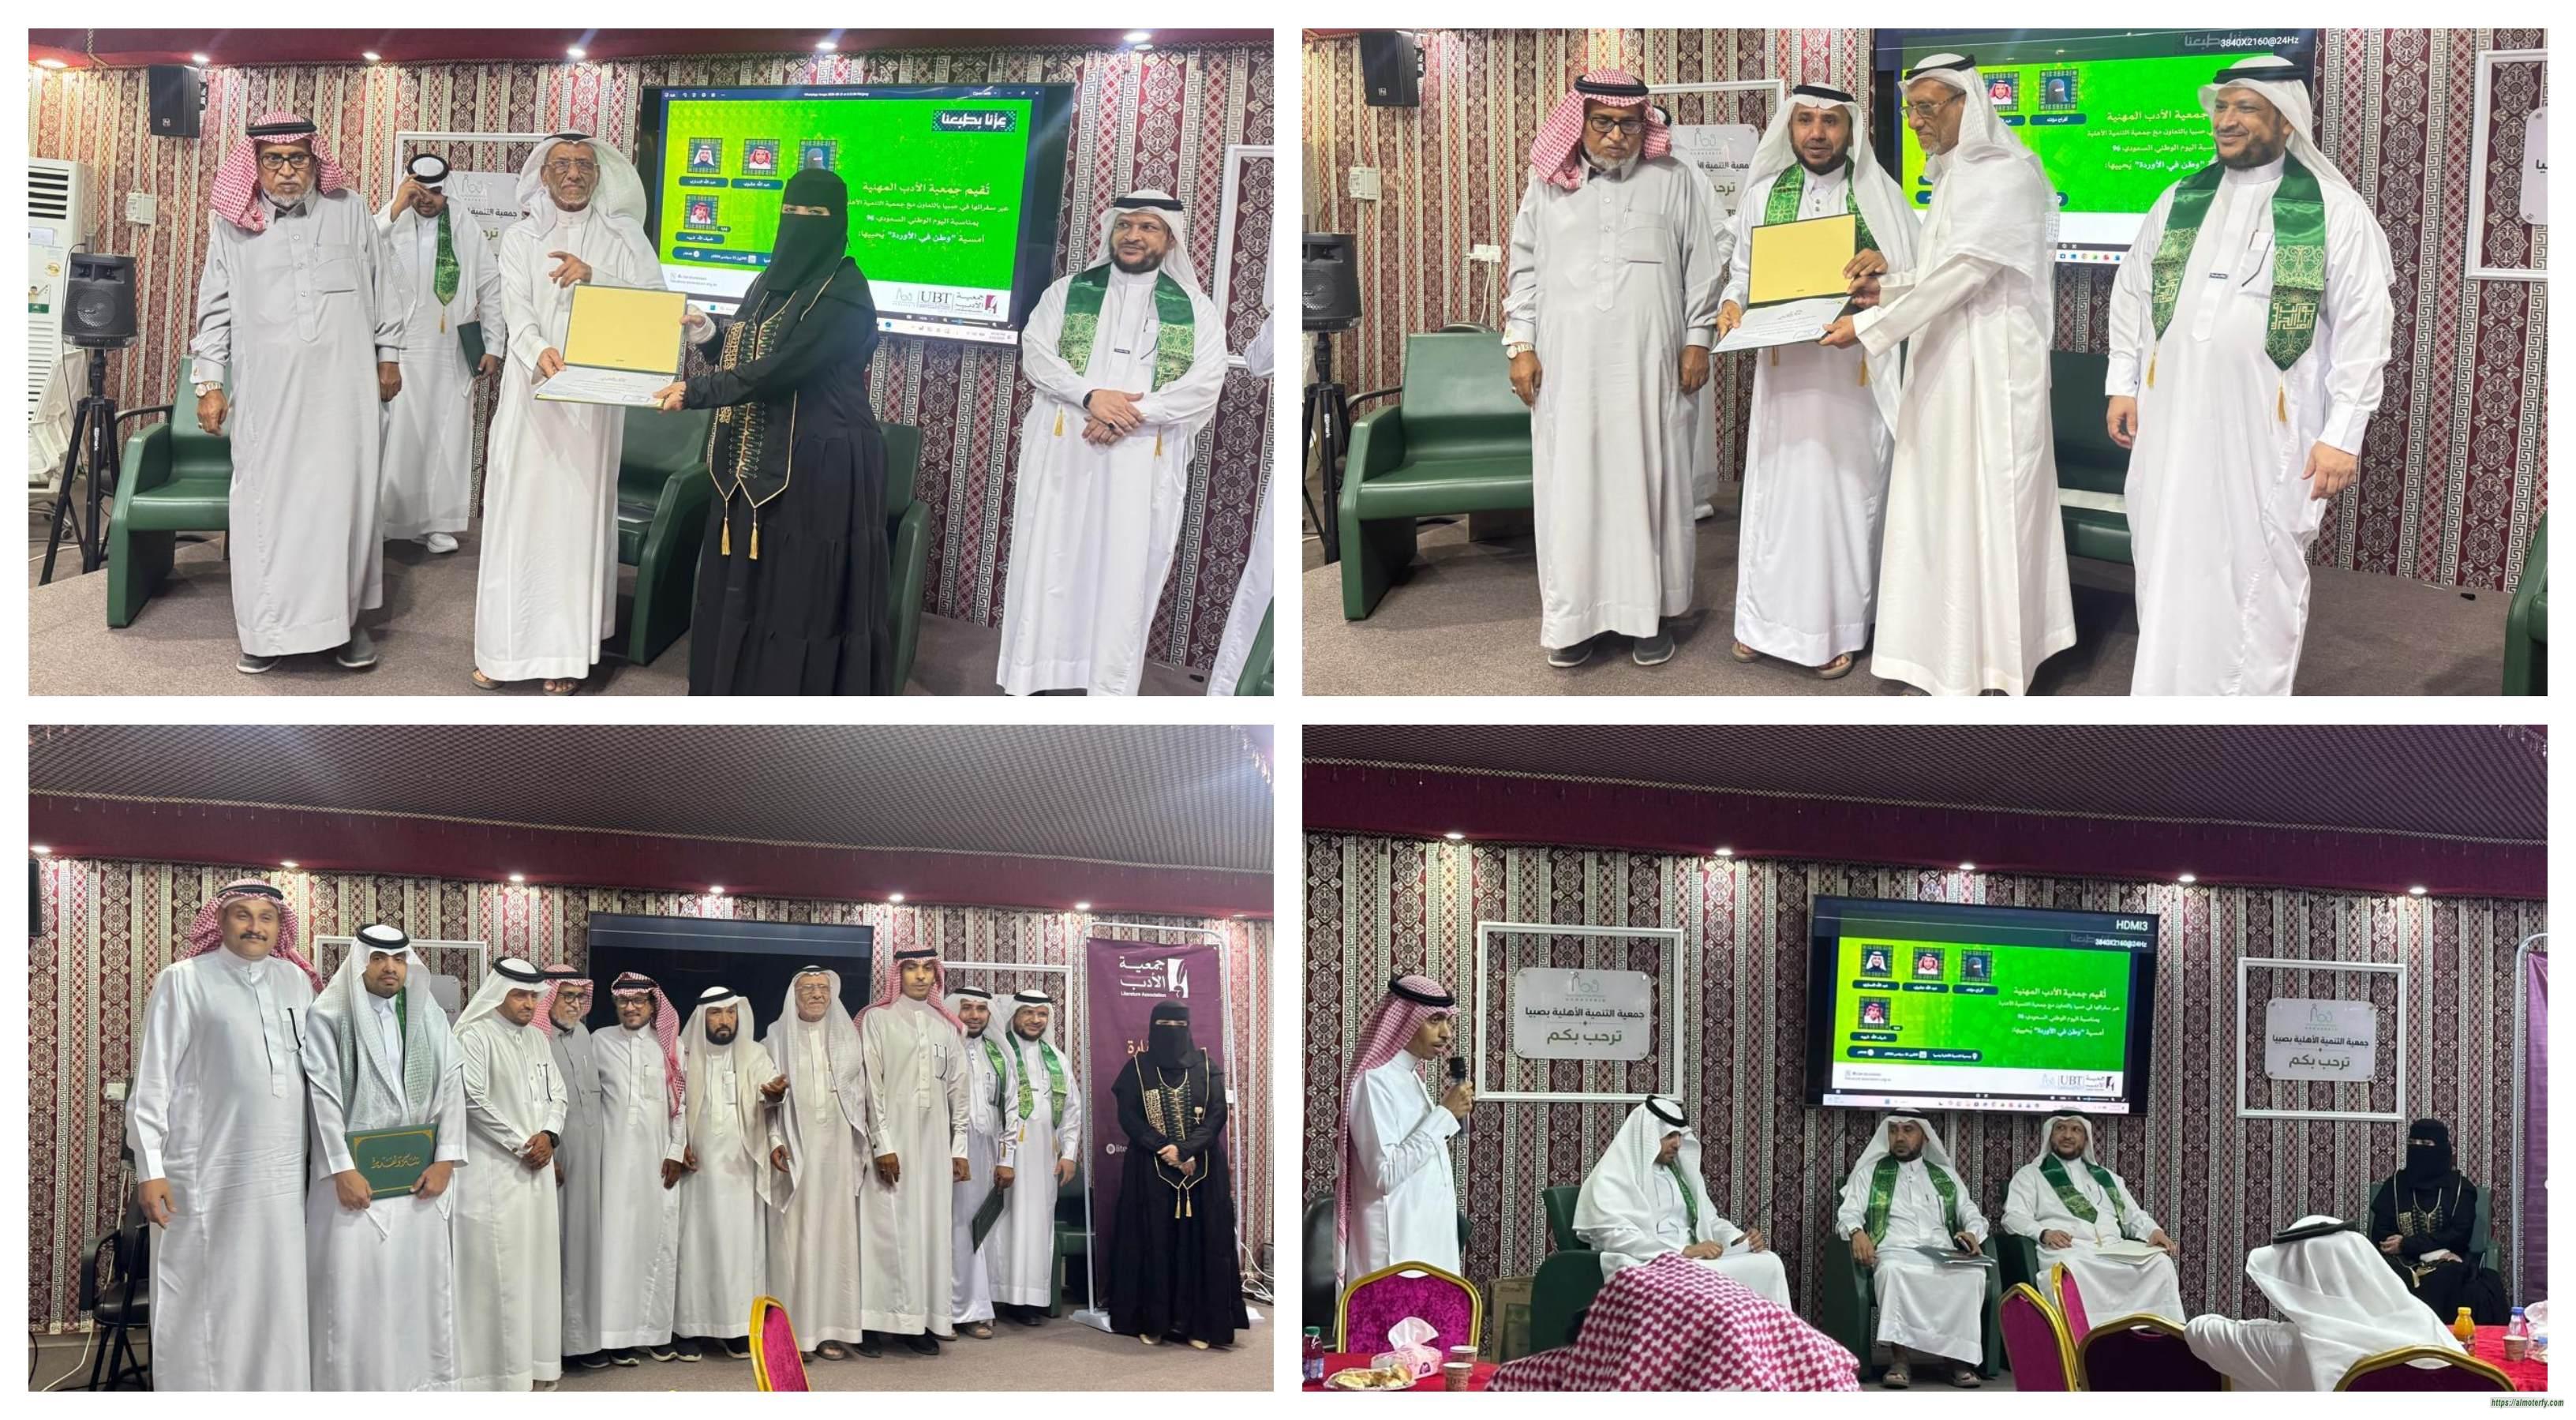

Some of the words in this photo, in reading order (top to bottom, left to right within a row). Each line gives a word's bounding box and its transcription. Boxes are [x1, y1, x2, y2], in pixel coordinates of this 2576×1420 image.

[2220, 36, 2299, 47] 3840X2160@24Hz
[2107, 111, 2142, 122] المهنية
[2144, 109, 2172, 122] الأدب
[2175, 110, 2209, 122] جمعية
[2122, 144, 2153, 152] السعودي
[2155, 144, 2178, 153] الوطني
[1705, 161, 1729, 172] التنمية
[2166, 160, 2179, 171] في
[900, 182, 926, 194] الأدب
[470, 207, 494, 217] التنمية
[496, 208, 518, 217] جمعية
[933, 217, 949, 227] اليوم
[918, 232, 931, 243] في
[921, 290, 953, 304] UBT
[956, 291, 984, 302] جمعية
[2116, 920, 2147, 931] HDMI3
[1119, 955, 1166, 972] جمعية
[1120, 972, 1166, 991] الأدب
[1525, 1006, 1550, 1017] بصبيا
[1552, 1006, 1583, 1018] الأهلية
[1586, 1009, 1615, 1019] التنمية
[1617, 1010, 1645, 1021] جمعية
[1547, 1028, 1579, 1045] بكم
[1583, 1029, 1622, 1046] ترحب
[2272, 1034, 2293, 1044] بصبيا
[2294, 1035, 2319, 1045] الأهلية
[2320, 1036, 2345, 1047] التنمية
[2346, 1037, 2369, 1048] جمعية
[2289, 1054, 2315, 1070] بكم
[2318, 1055, 2350, 1070] ترحب
[2061, 1075, 2084, 1086] UBT
